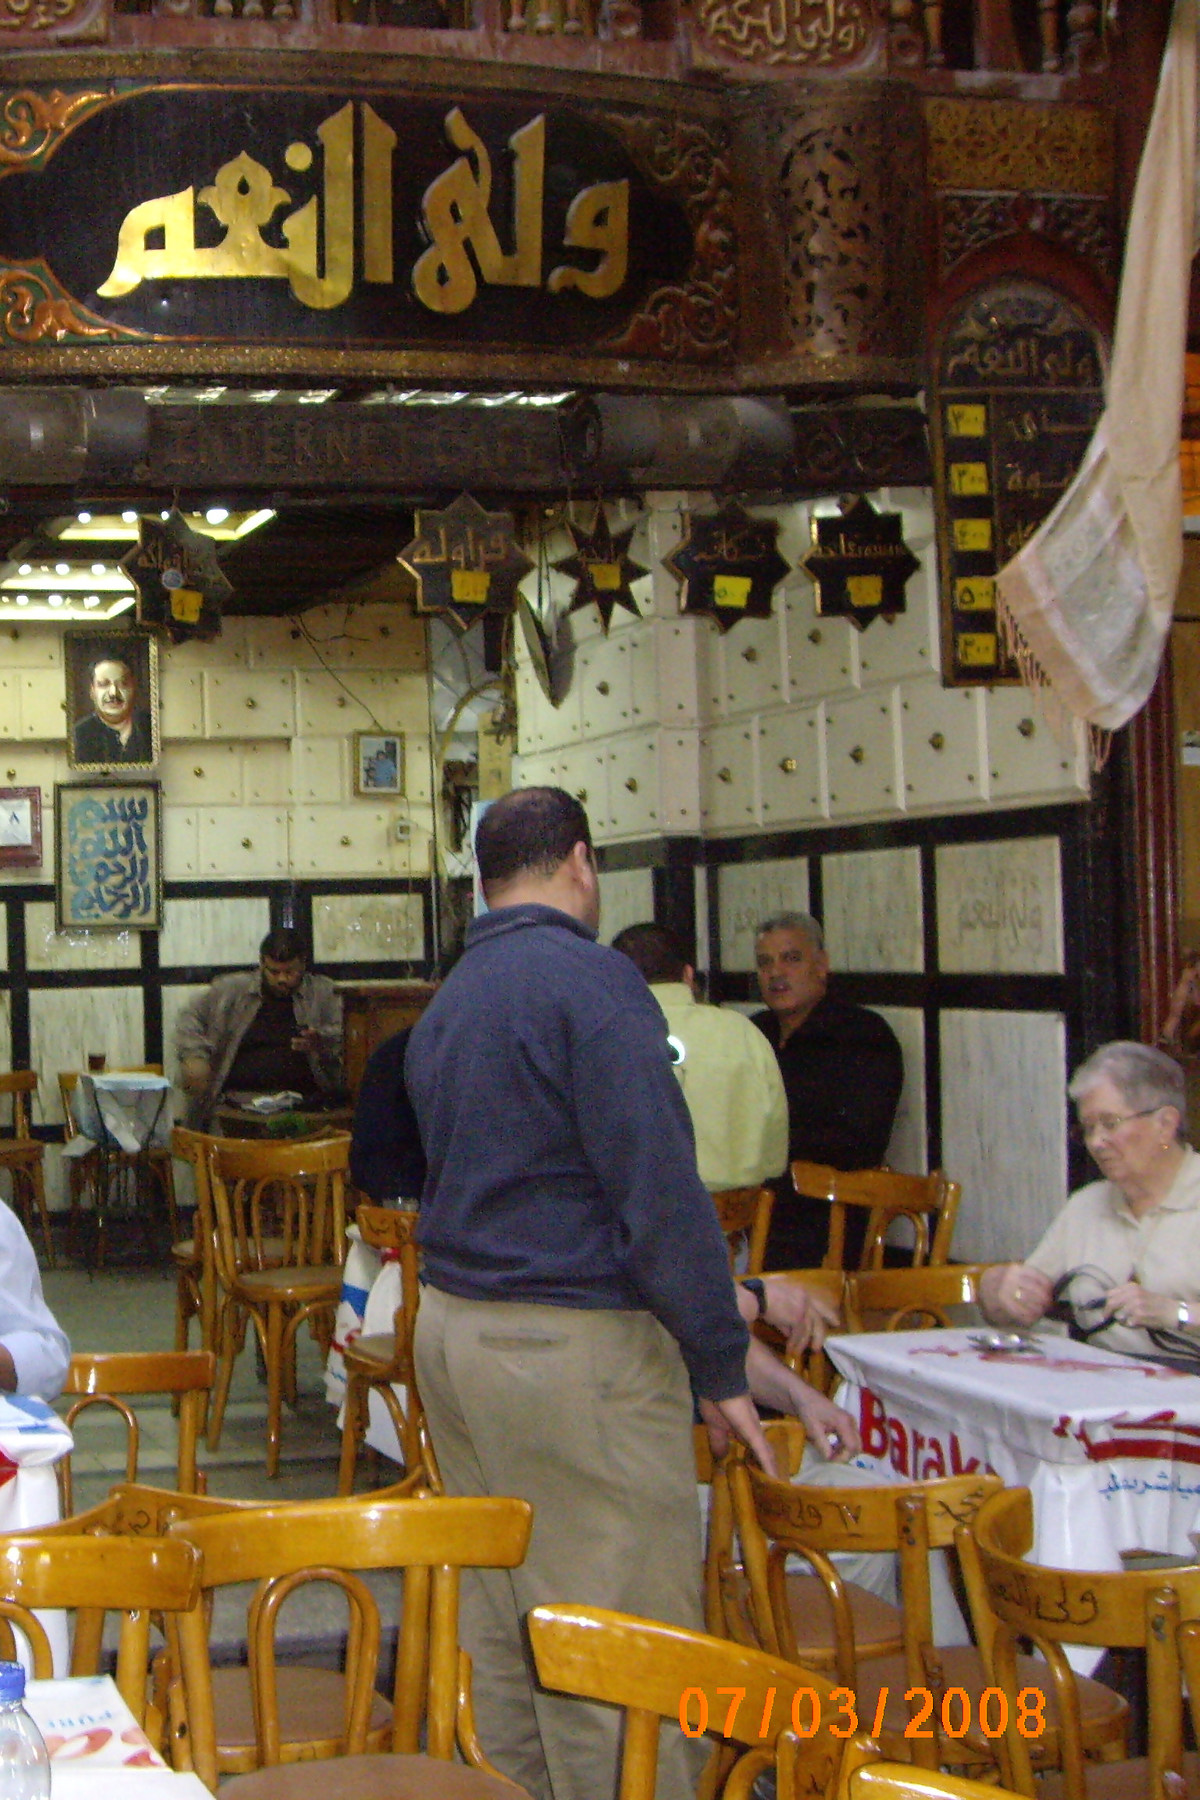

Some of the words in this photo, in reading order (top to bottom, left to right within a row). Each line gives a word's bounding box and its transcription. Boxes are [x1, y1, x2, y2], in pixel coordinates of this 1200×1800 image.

[97, 99, 397, 309] النعم
[413, 106, 629, 314] ولى
[860, 1386, 998, 1483] Barak
